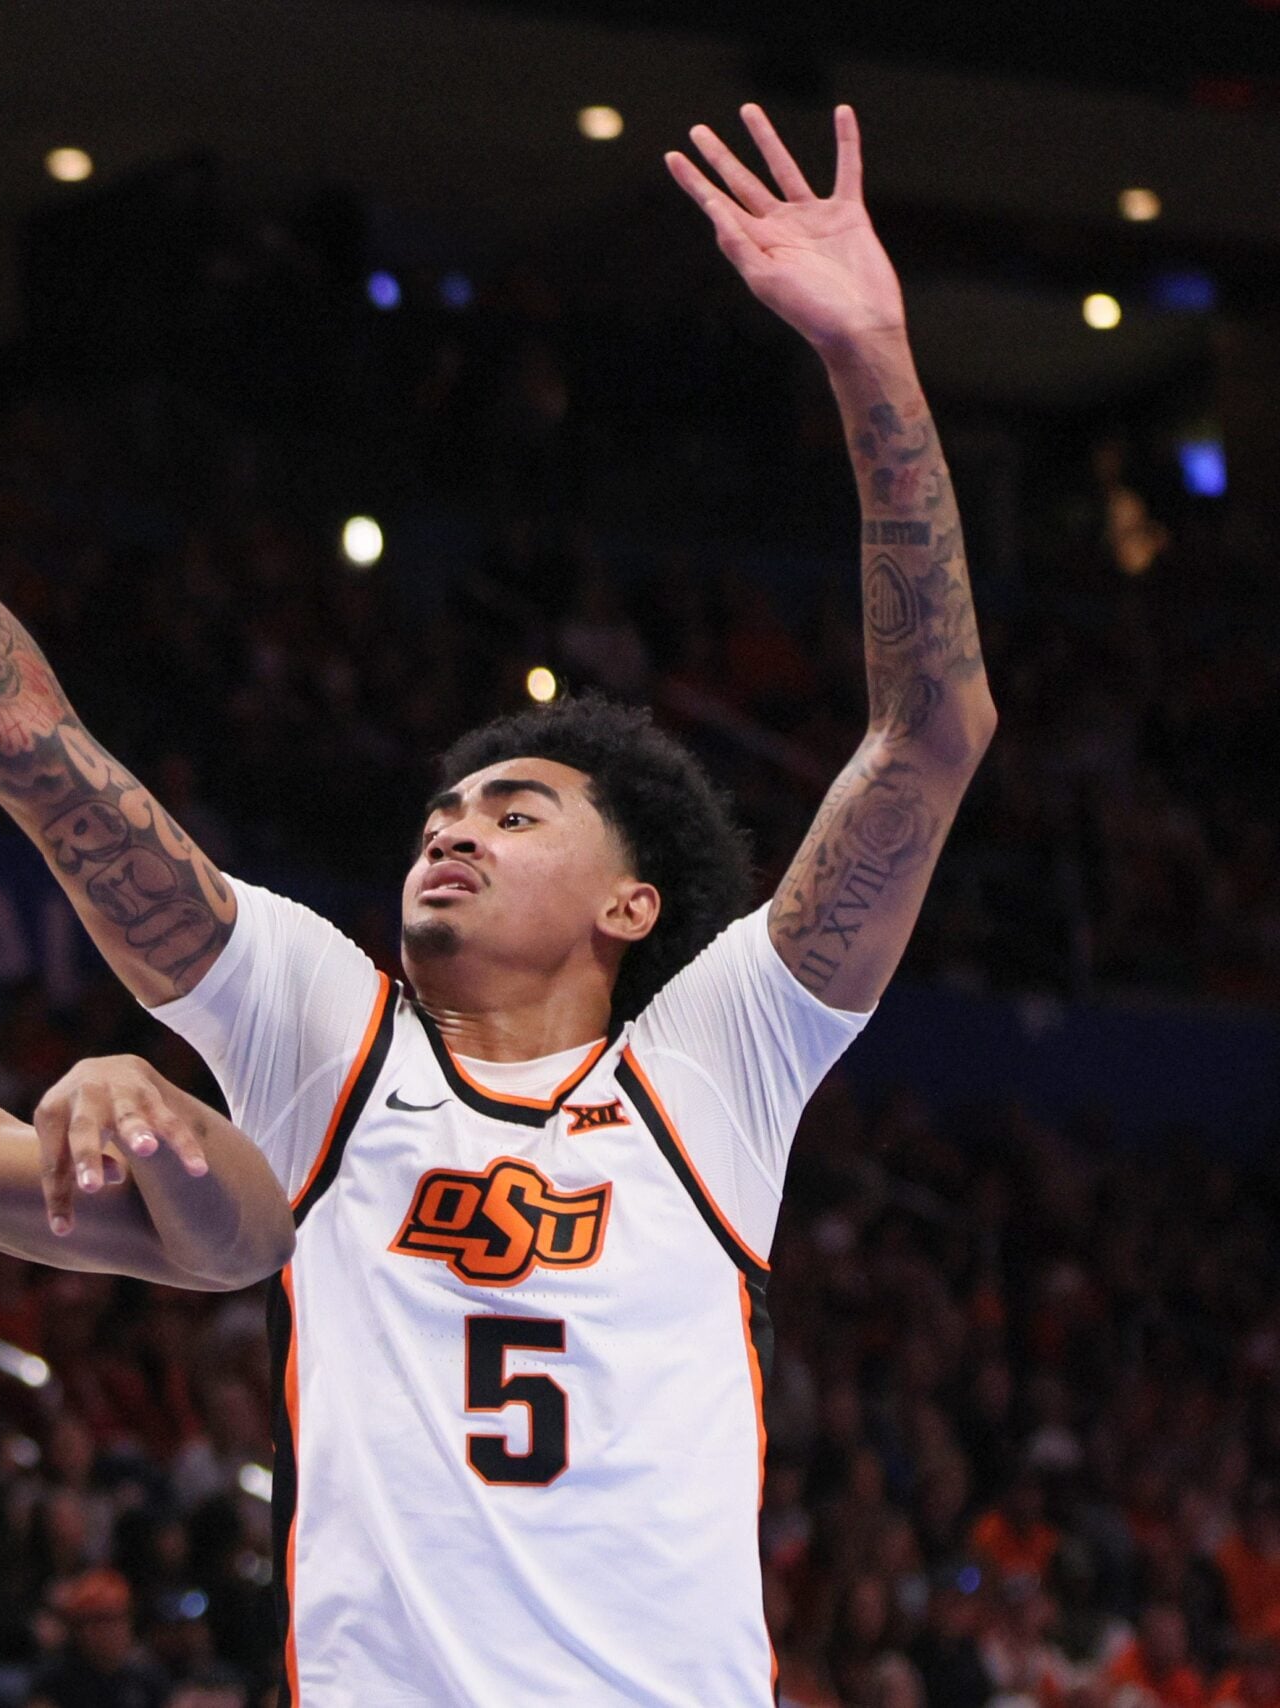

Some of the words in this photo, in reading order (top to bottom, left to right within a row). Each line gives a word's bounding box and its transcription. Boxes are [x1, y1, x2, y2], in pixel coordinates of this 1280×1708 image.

[563, 1099, 628, 1133] XII
[394, 1158, 608, 1285] OSU
[464, 1314, 569, 1487] 5
